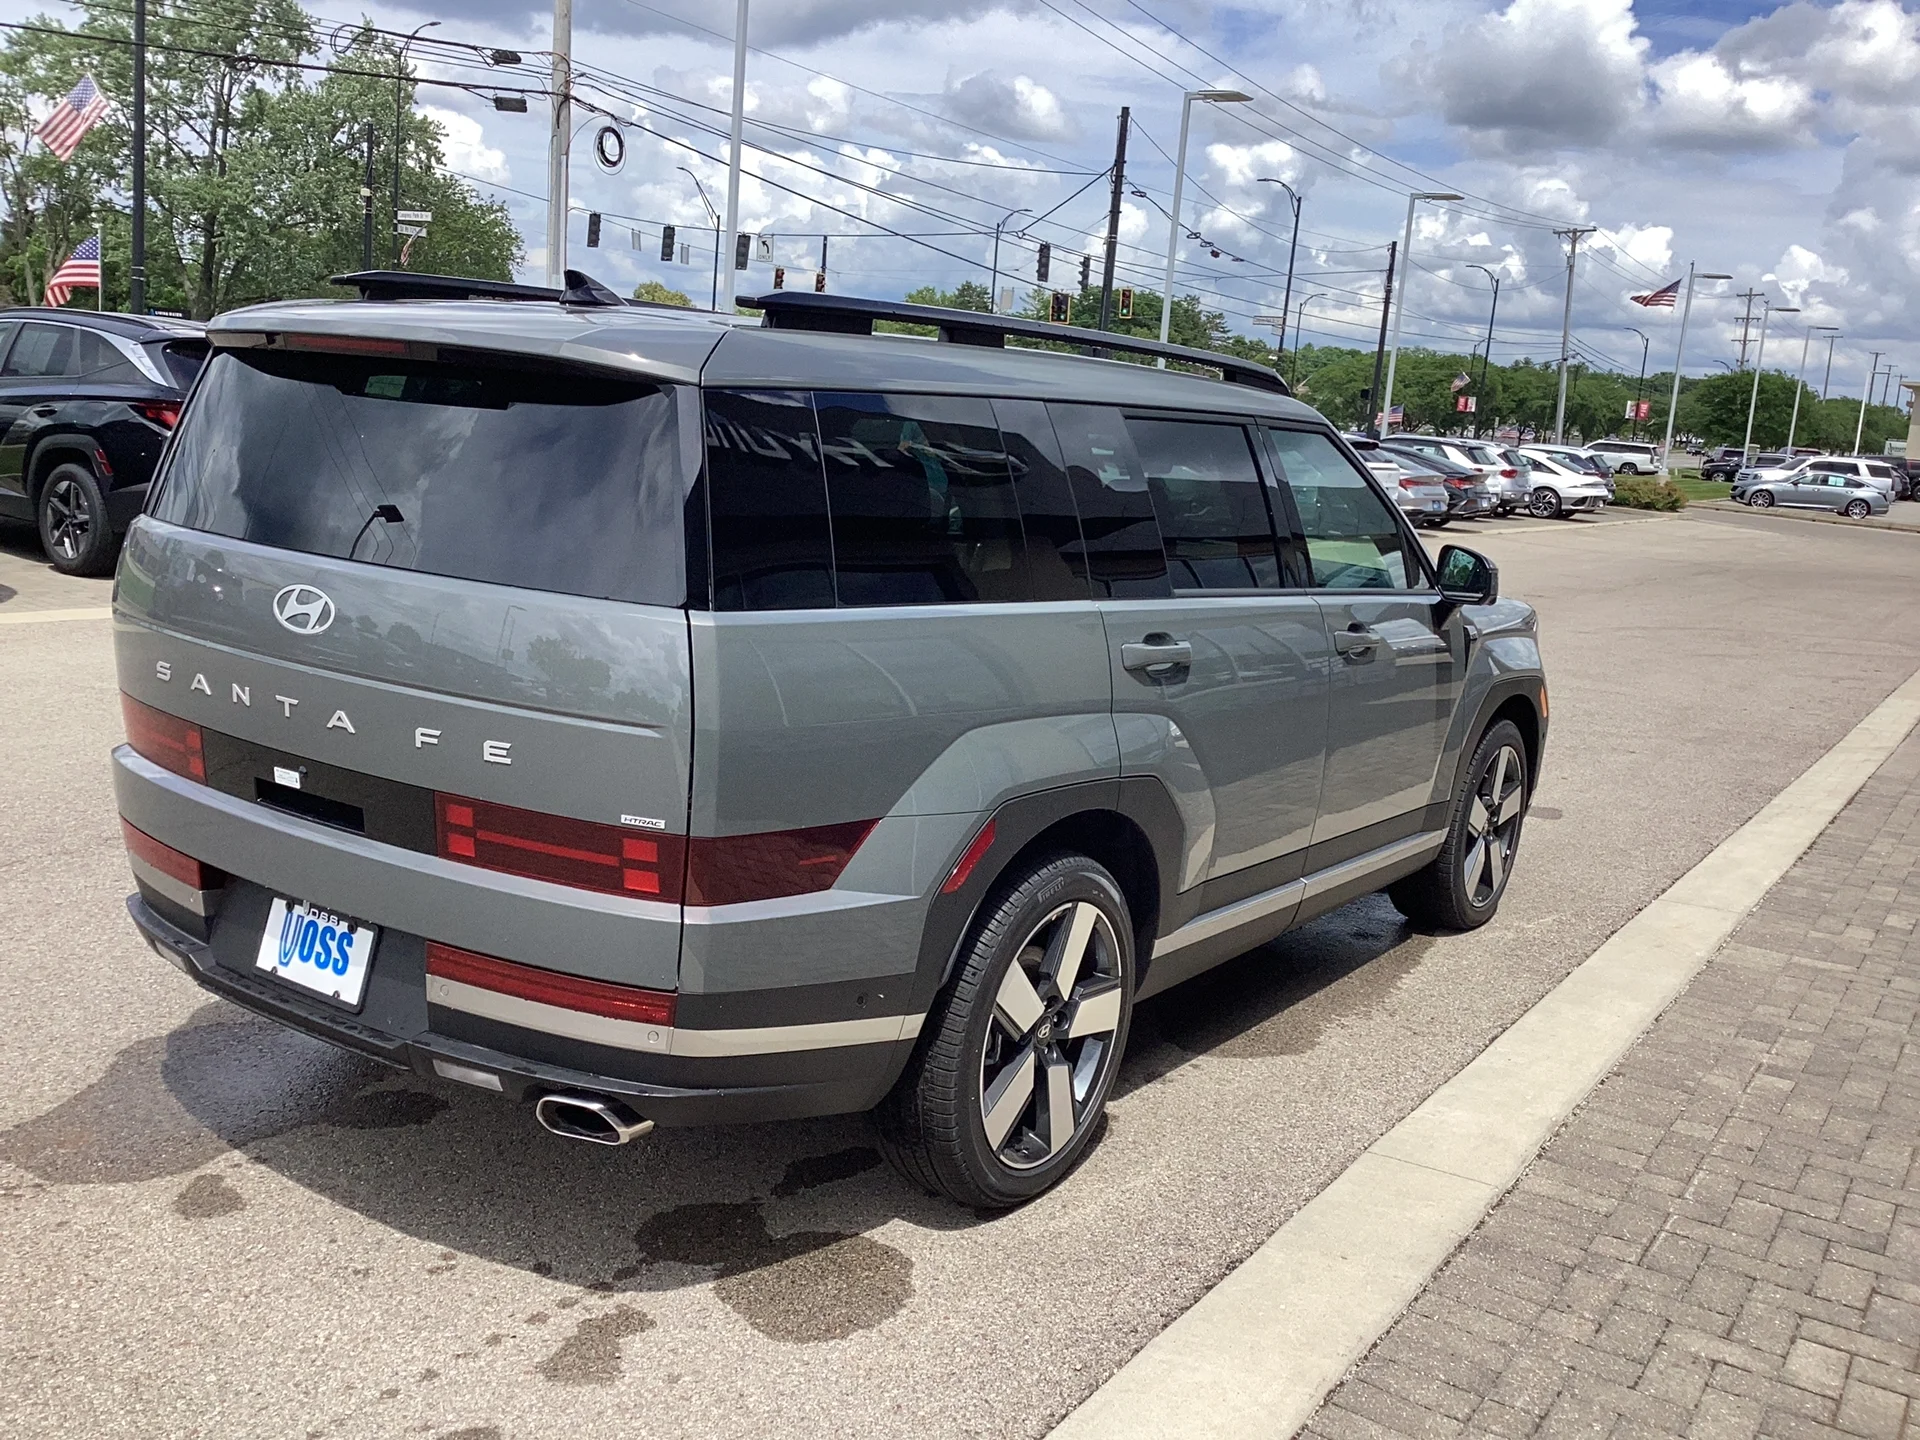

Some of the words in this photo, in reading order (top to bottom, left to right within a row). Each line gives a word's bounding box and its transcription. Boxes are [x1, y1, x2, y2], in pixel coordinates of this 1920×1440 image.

[156, 661, 356, 734] SANTA
[414, 727, 512, 765] FE
[624, 816, 662, 827] HTRAC
